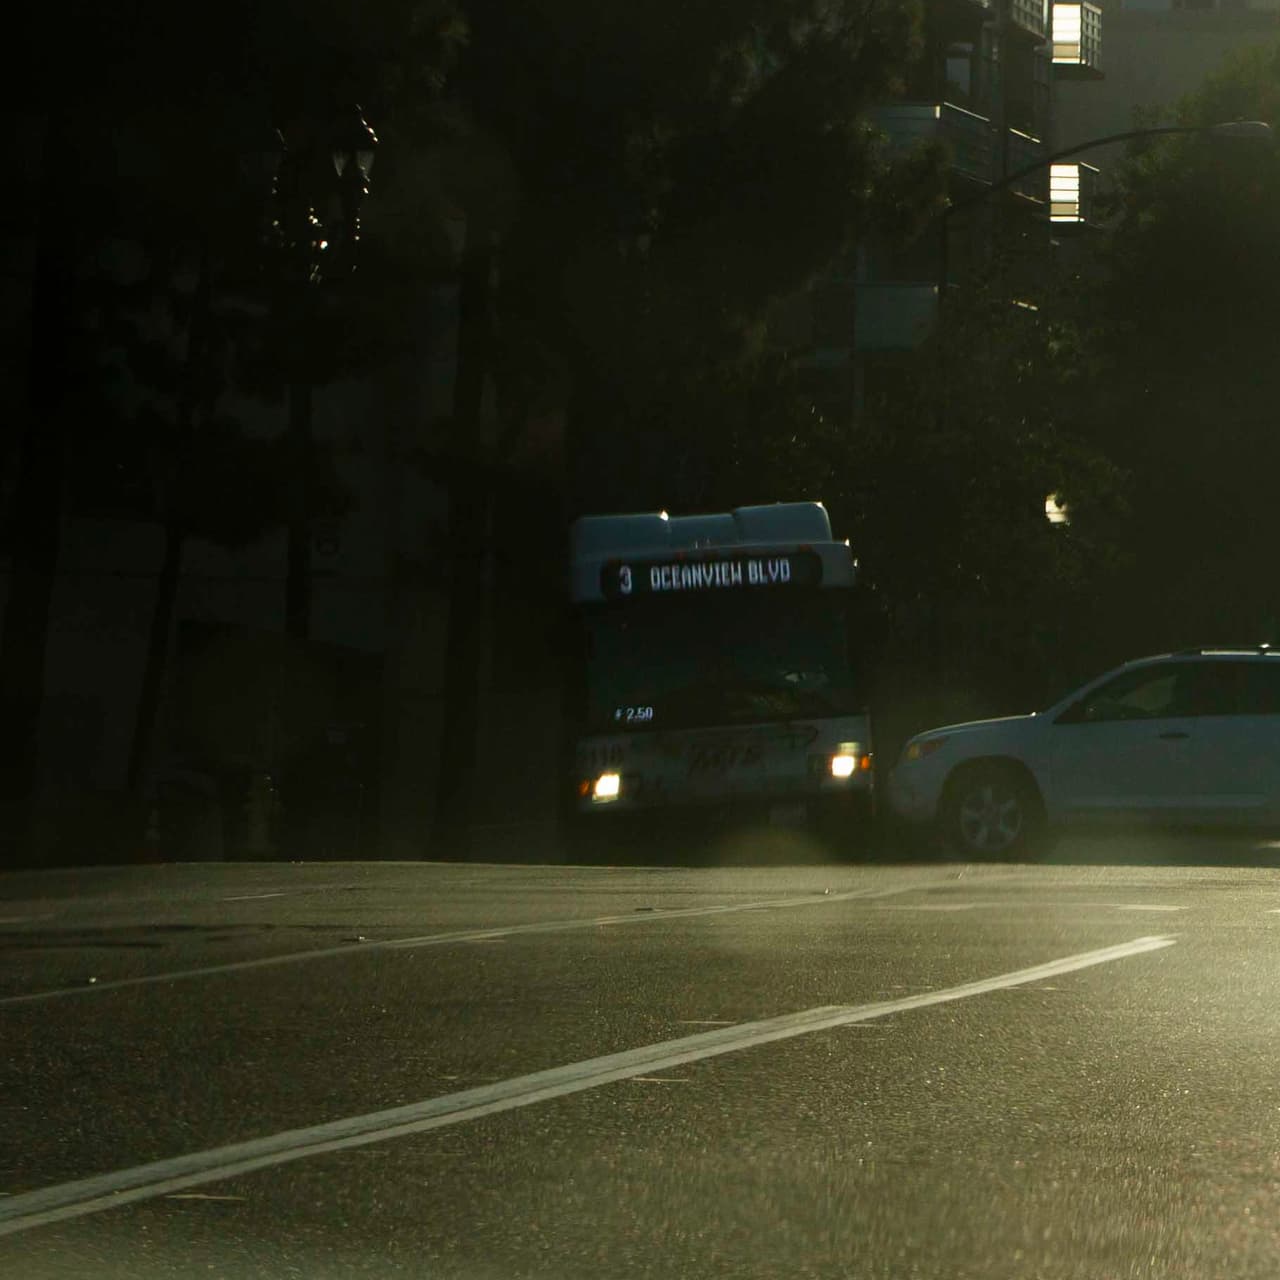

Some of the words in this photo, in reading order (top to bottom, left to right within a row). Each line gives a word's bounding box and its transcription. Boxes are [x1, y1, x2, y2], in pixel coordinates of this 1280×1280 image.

[619, 565, 633, 595] 3
[650, 561, 742, 592] OCEANVIEW
[747, 558, 791, 584] BLVD
